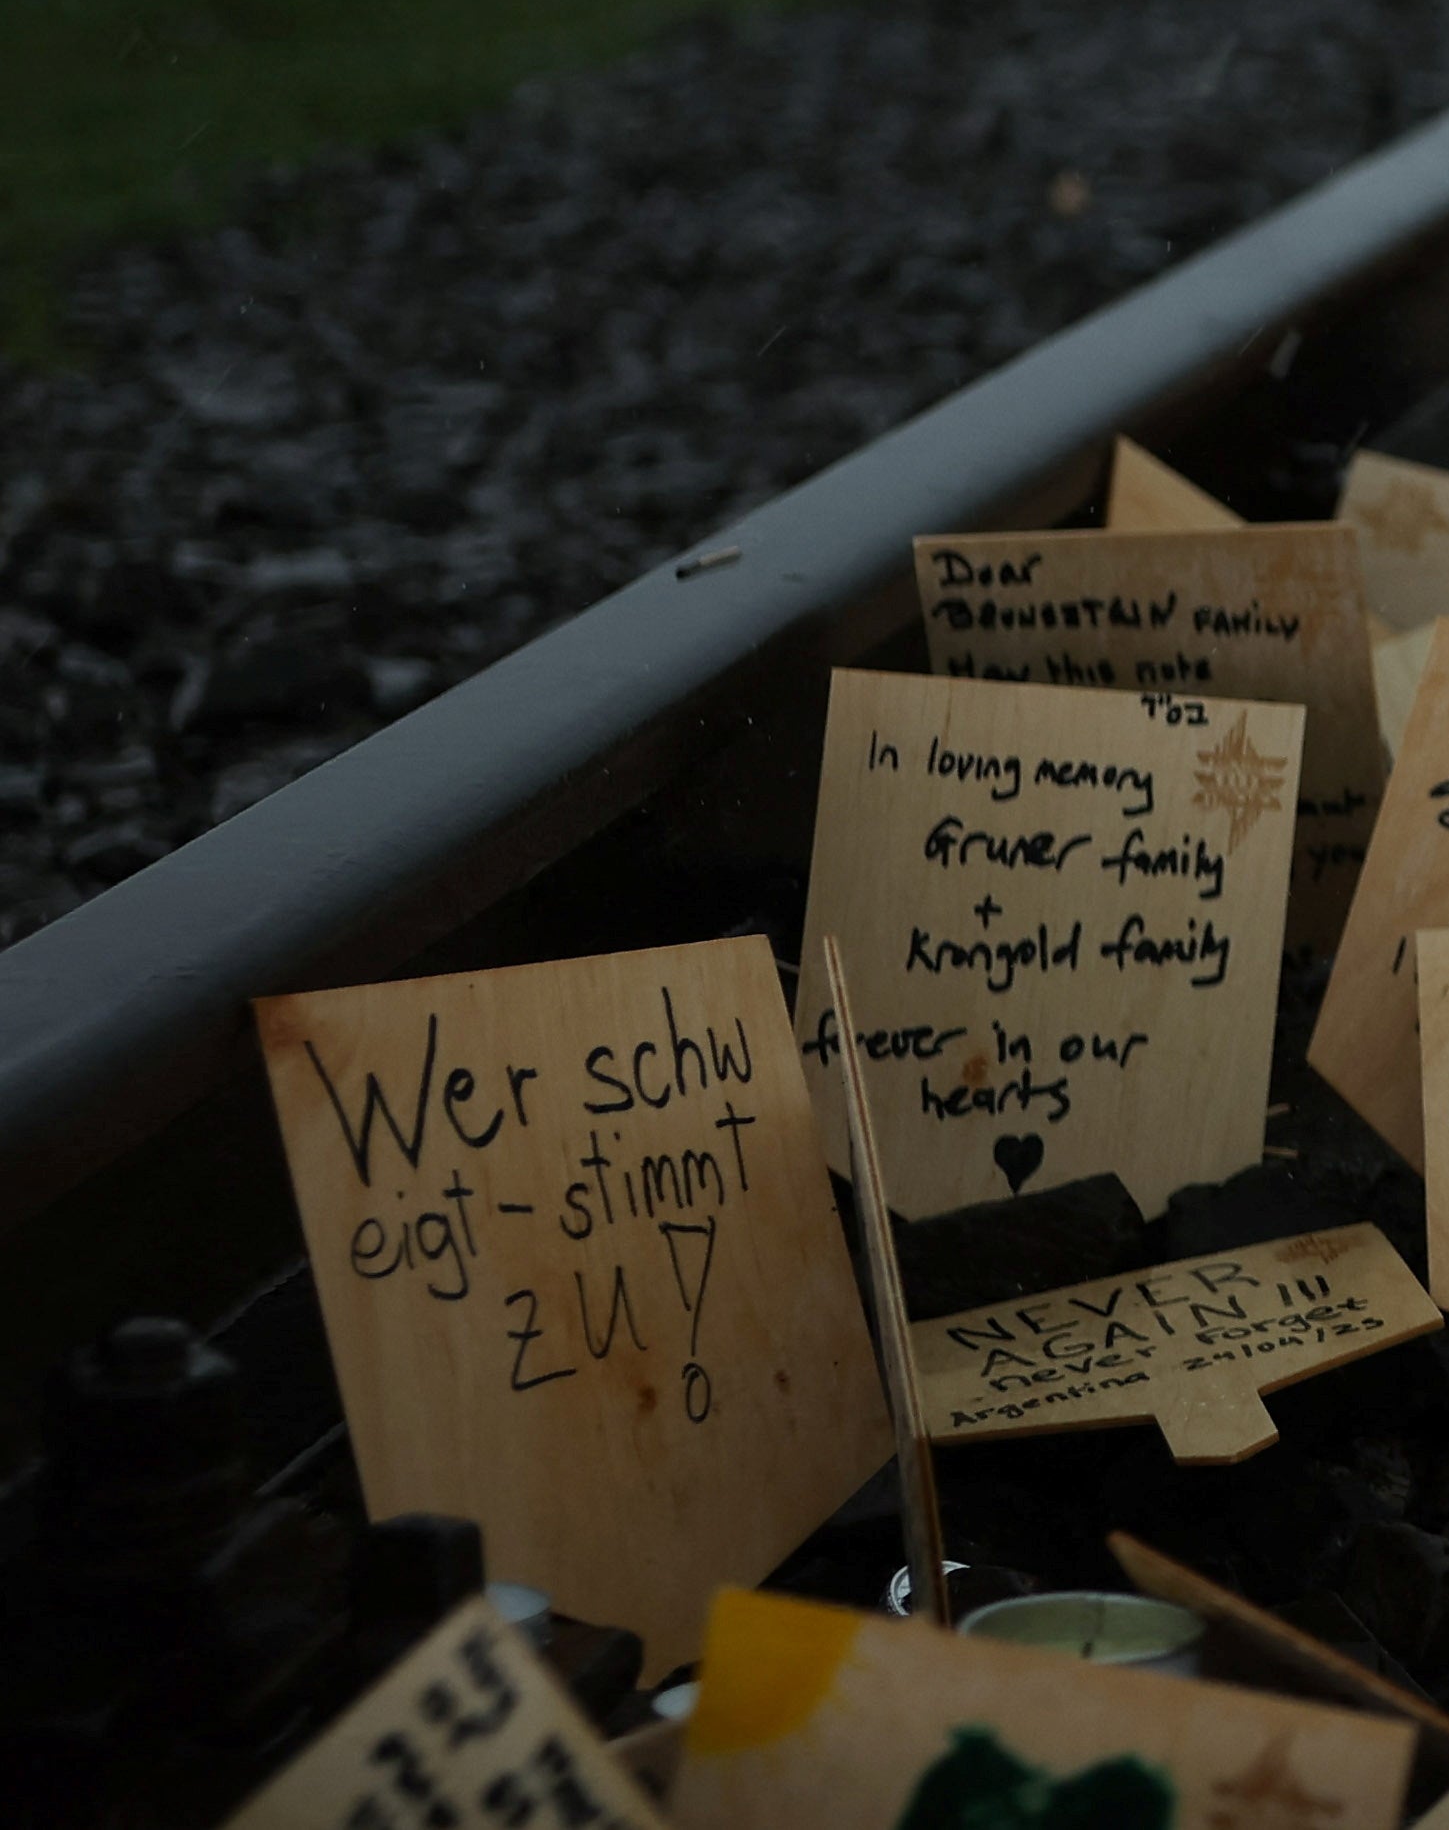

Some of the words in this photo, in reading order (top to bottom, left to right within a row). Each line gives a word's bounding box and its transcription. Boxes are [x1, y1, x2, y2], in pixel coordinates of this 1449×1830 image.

[868, 730, 900, 772] In
[927, 737, 1021, 801] loving
[1035, 758, 1154, 816] memory
[1102, 827, 1225, 898] family
[1102, 915, 1231, 987] family
[303, 1012, 539, 1188] Wer
[583, 985, 754, 1113] schw
[993, 1020, 1032, 1063] in
[1060, 1031, 1148, 1069] our
[921, 1068, 1070, 1125] hearts
[350, 1169, 477, 1301] eigt
[559, 1101, 757, 1240] stimmt
[945, 1261, 1262, 1352] NEVER
[979, 1294, 1249, 1378] AGAIN
[989, 1344, 1158, 1393] never
[1193, 1296, 1371, 1346] forget
[949, 1369, 1152, 1429] Argentina
